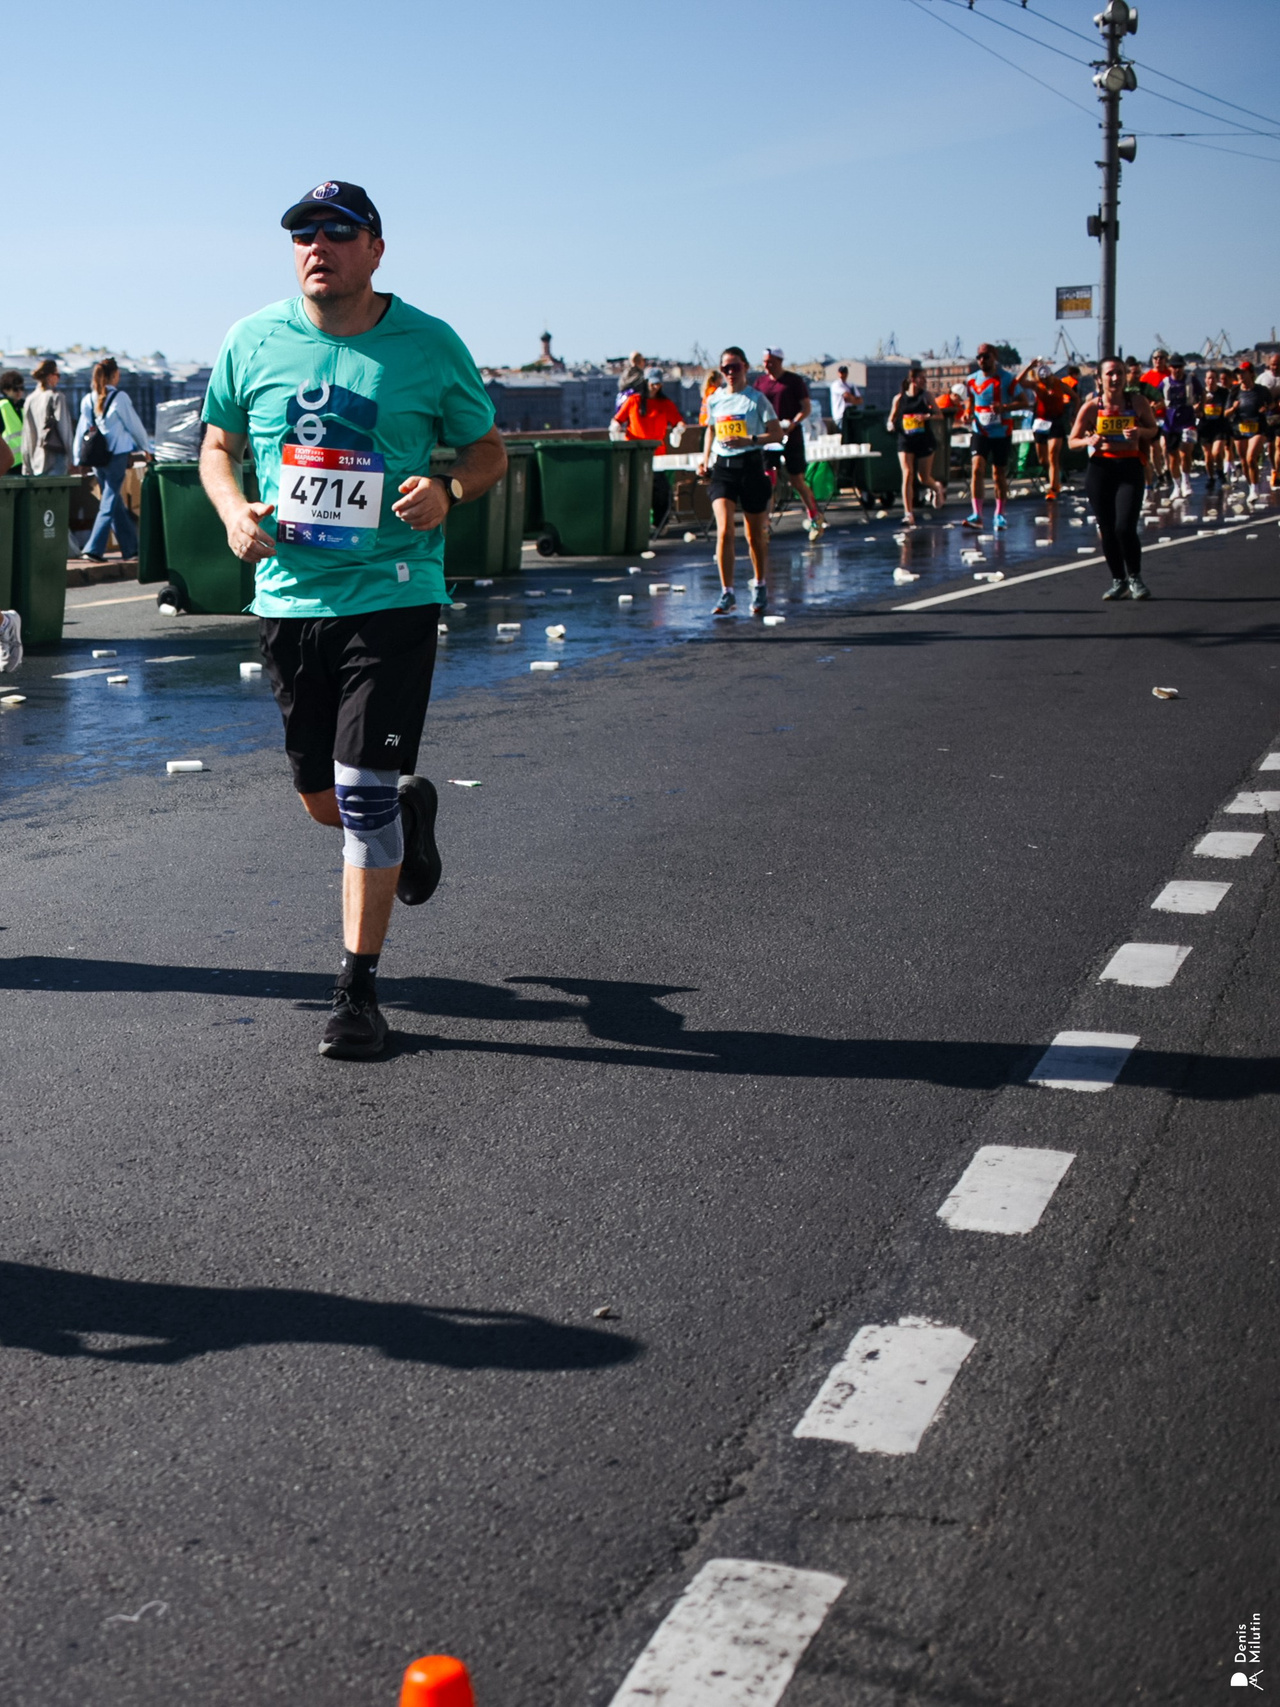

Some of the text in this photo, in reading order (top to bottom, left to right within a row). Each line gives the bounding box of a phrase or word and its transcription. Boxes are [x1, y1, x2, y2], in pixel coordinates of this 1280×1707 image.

[294, 453, 325, 463] МАРАФОН
[338, 456, 355, 466] 21,1
[290, 475, 368, 510] 4714
[311, 509, 342, 520] VADIM
[285, 523, 296, 540] E
